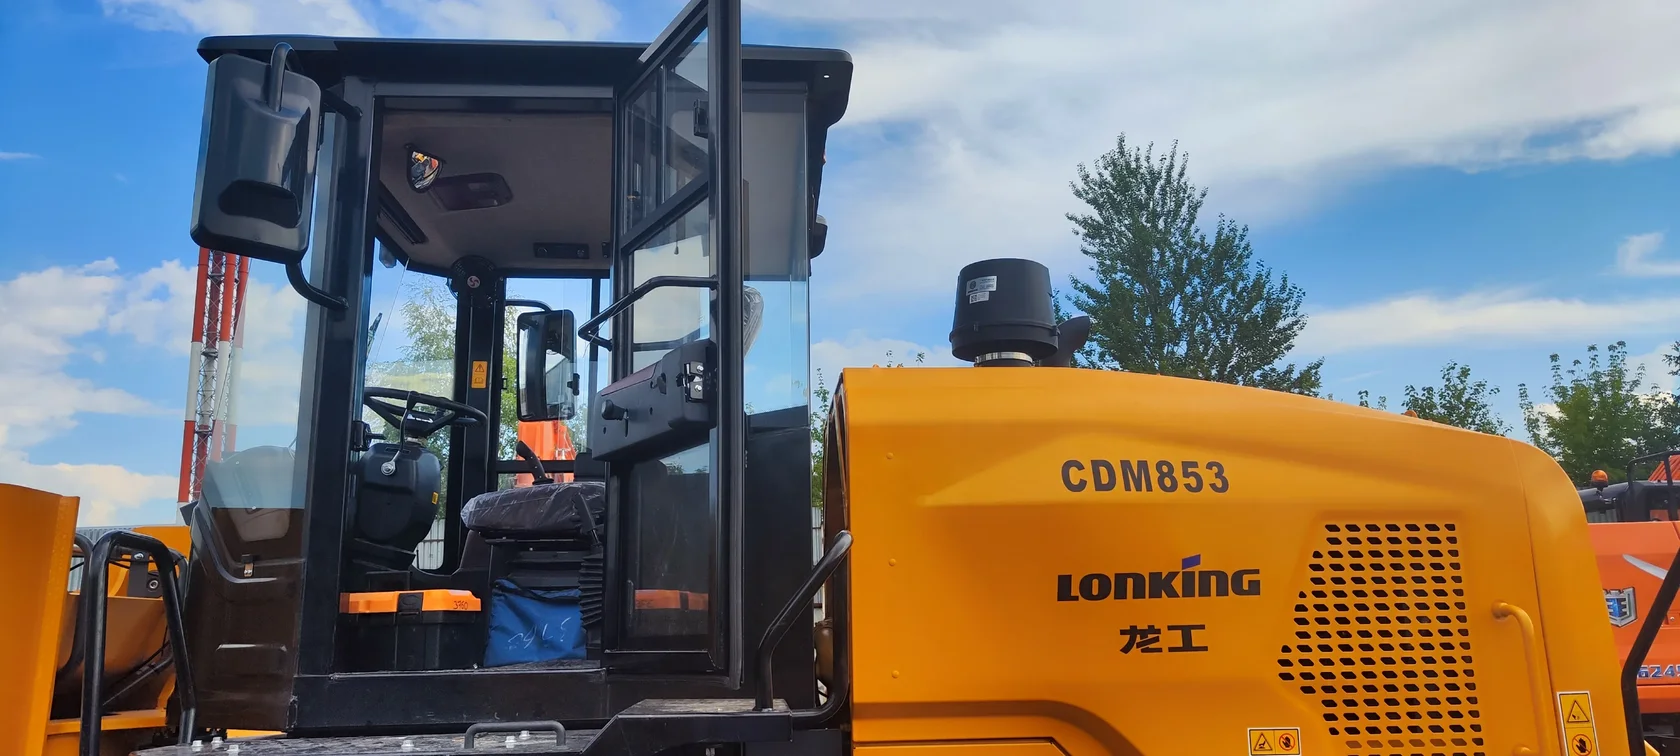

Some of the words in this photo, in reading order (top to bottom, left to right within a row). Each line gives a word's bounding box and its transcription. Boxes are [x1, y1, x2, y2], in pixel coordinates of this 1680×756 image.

[1061, 459, 1229, 493] CDM853
[1057, 554, 1260, 601] LONKING
[1120, 624, 1208, 654] 龙工
